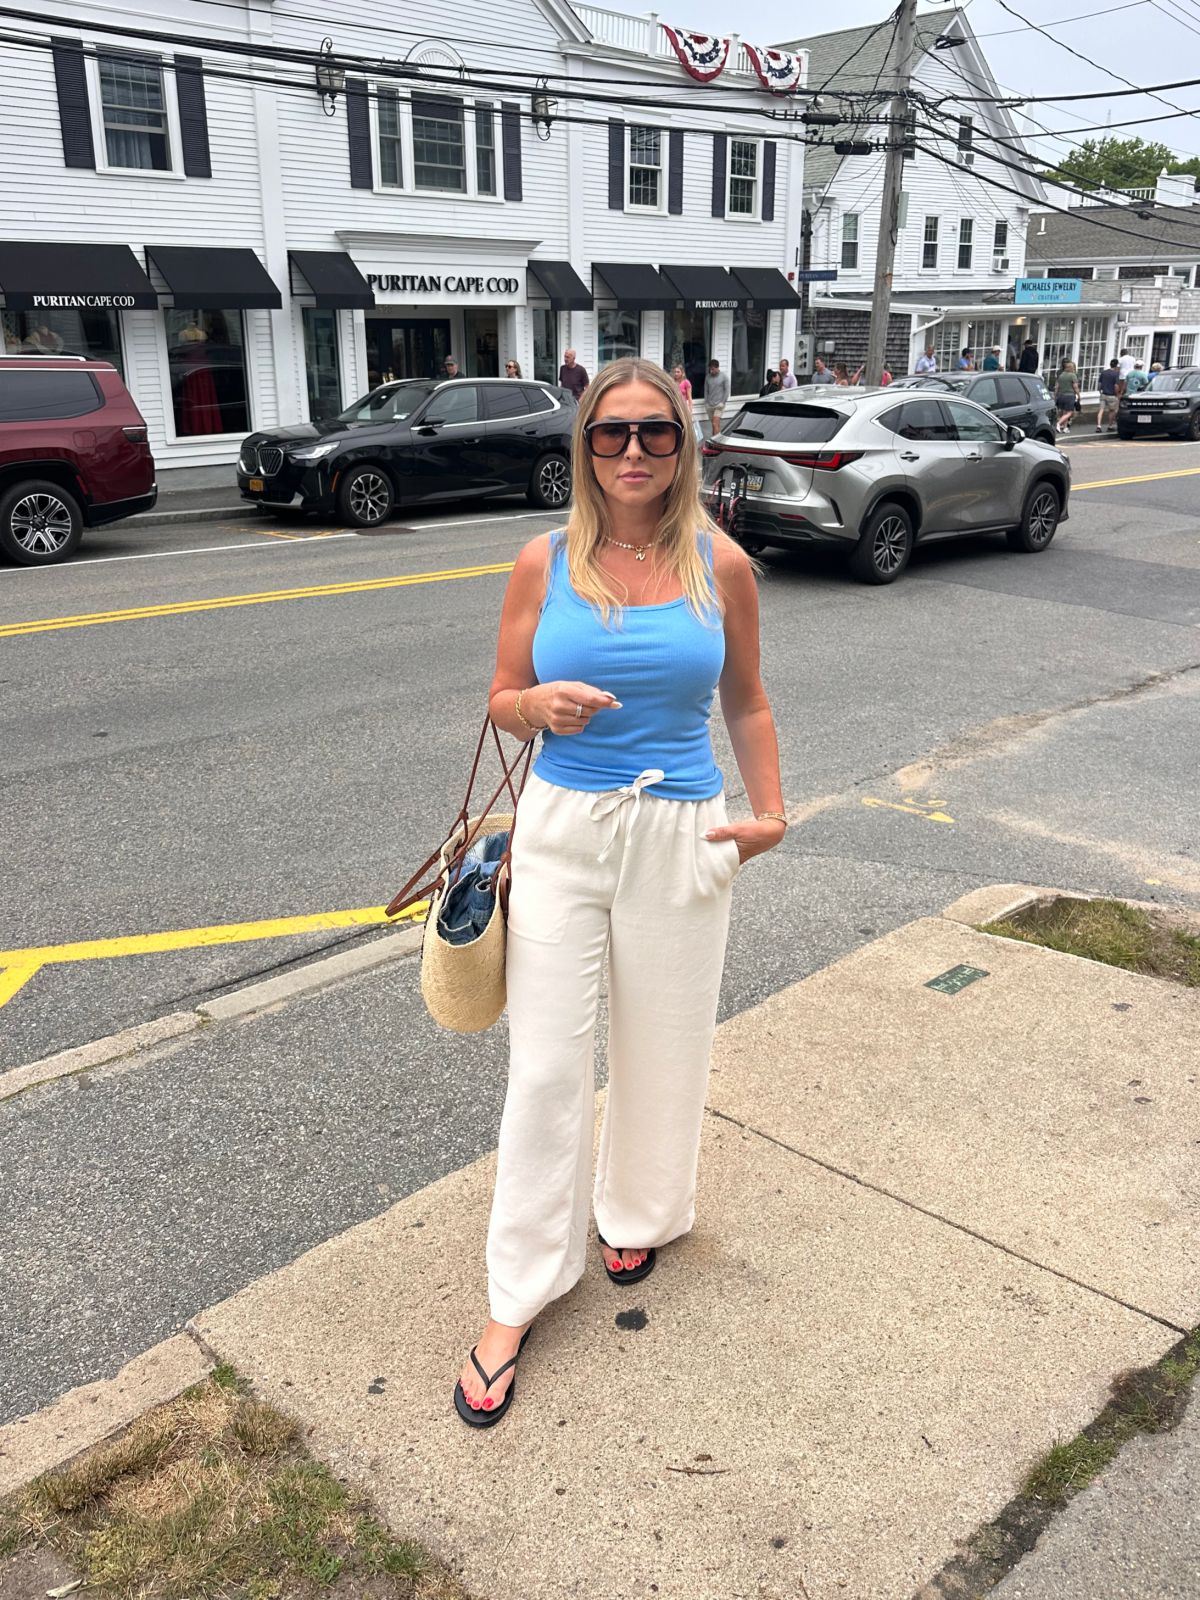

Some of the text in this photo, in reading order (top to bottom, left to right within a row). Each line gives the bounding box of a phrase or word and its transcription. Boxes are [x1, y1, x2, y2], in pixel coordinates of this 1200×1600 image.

[367, 274, 519, 293] PURITAN CAPE COD
[1021, 282, 1077, 293] MICHAELS JEWELRY
[33, 295, 135, 307] PURITAN CAPE COD
